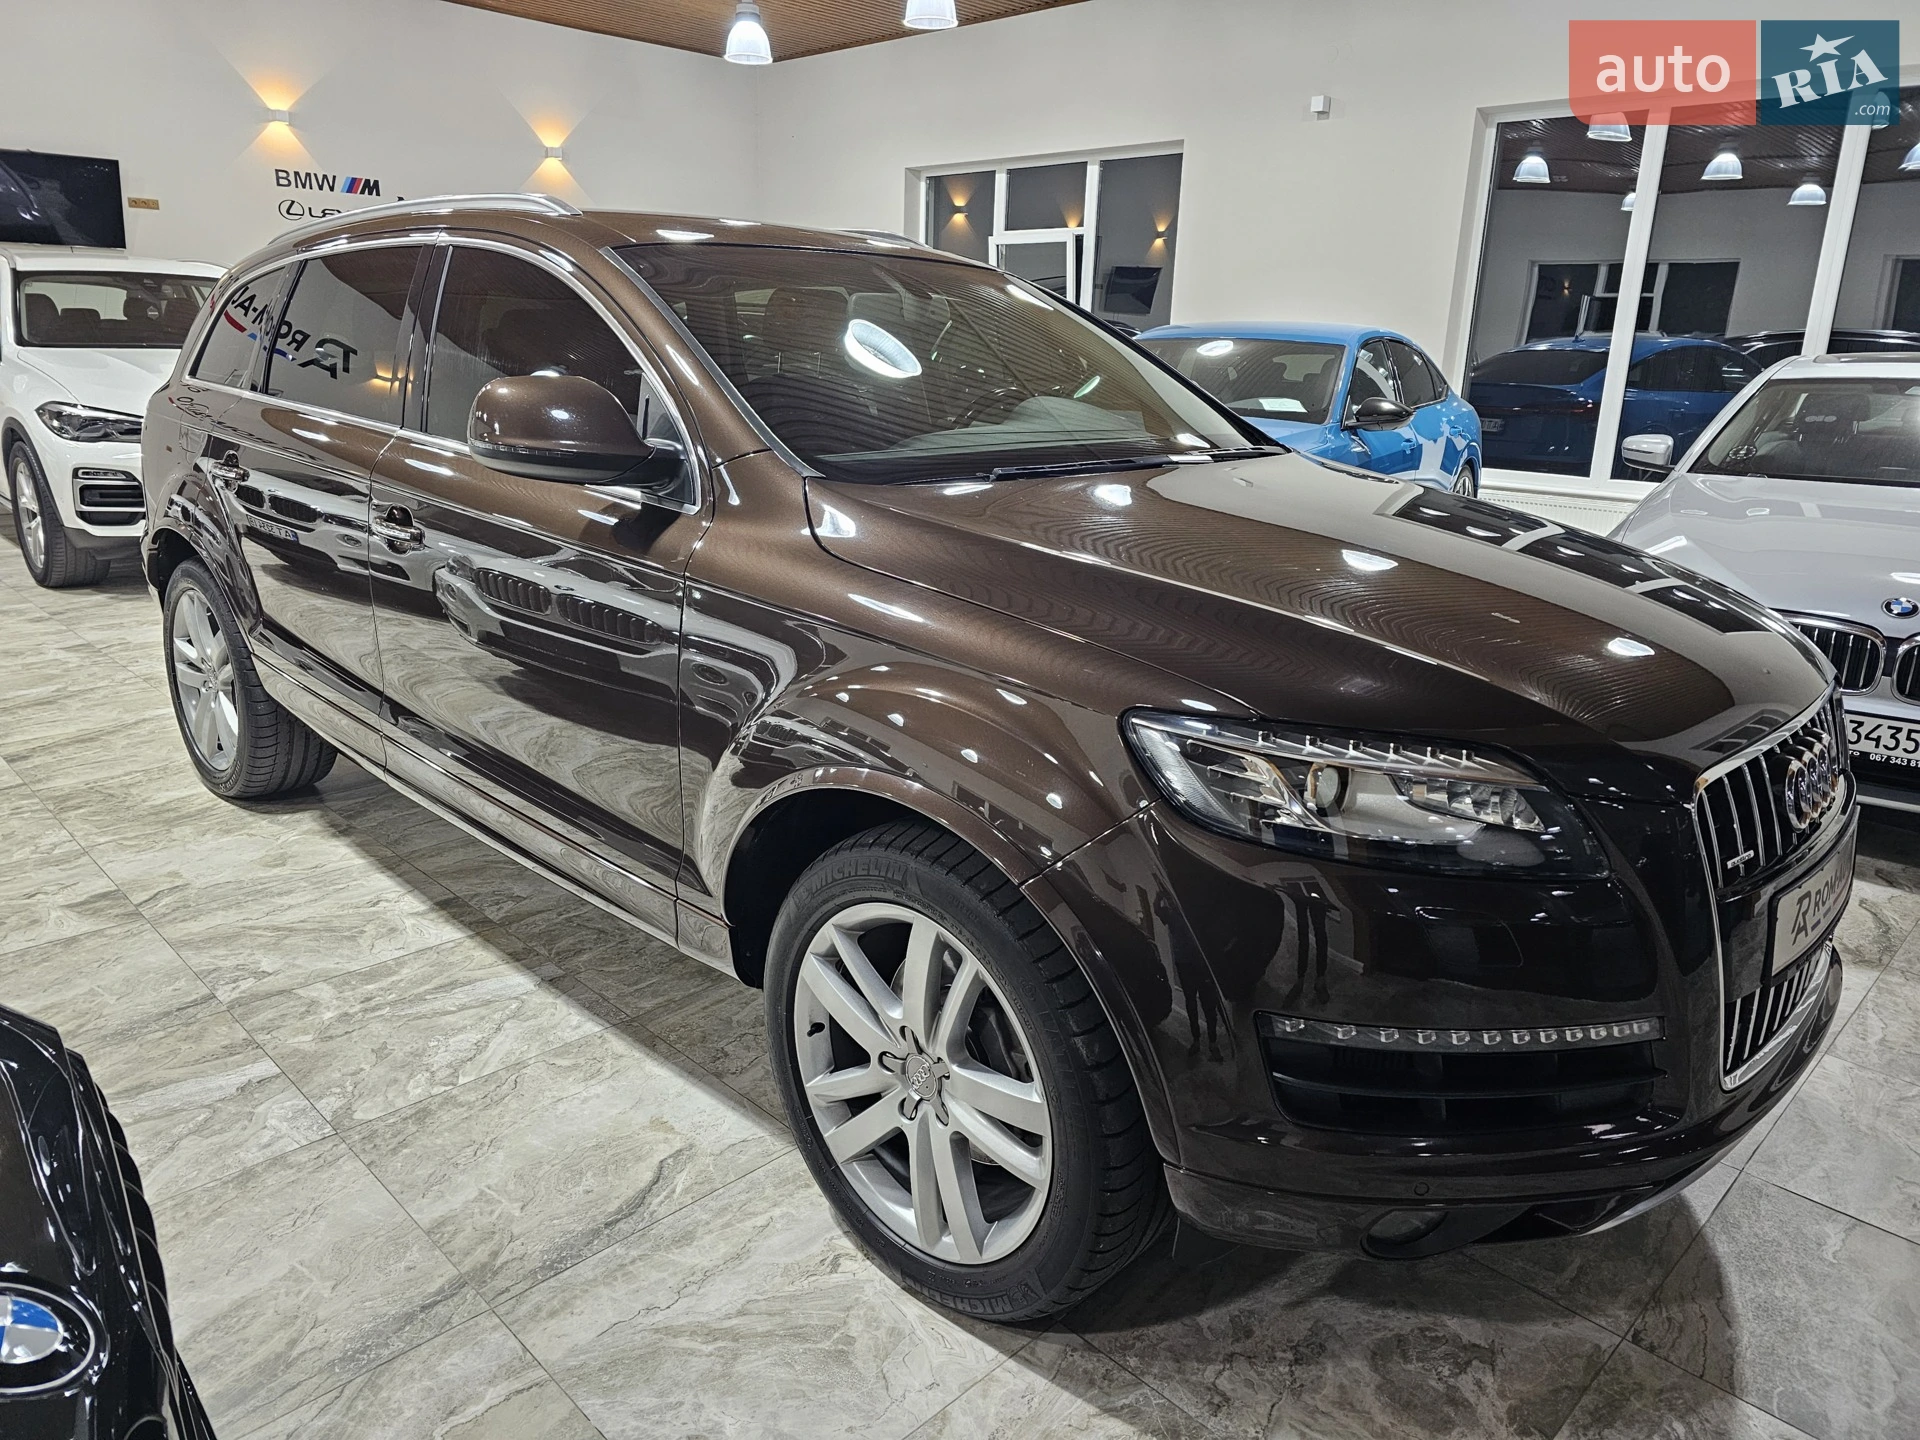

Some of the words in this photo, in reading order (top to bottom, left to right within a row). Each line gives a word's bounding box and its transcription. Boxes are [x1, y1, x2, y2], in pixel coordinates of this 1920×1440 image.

[274, 168, 337, 193] BMW
[1848, 719, 1920, 754] 3435
[1869, 753, 1888, 762] 067
[1889, 757, 1908, 766] 343
[812, 857, 908, 892] MICHELIN
